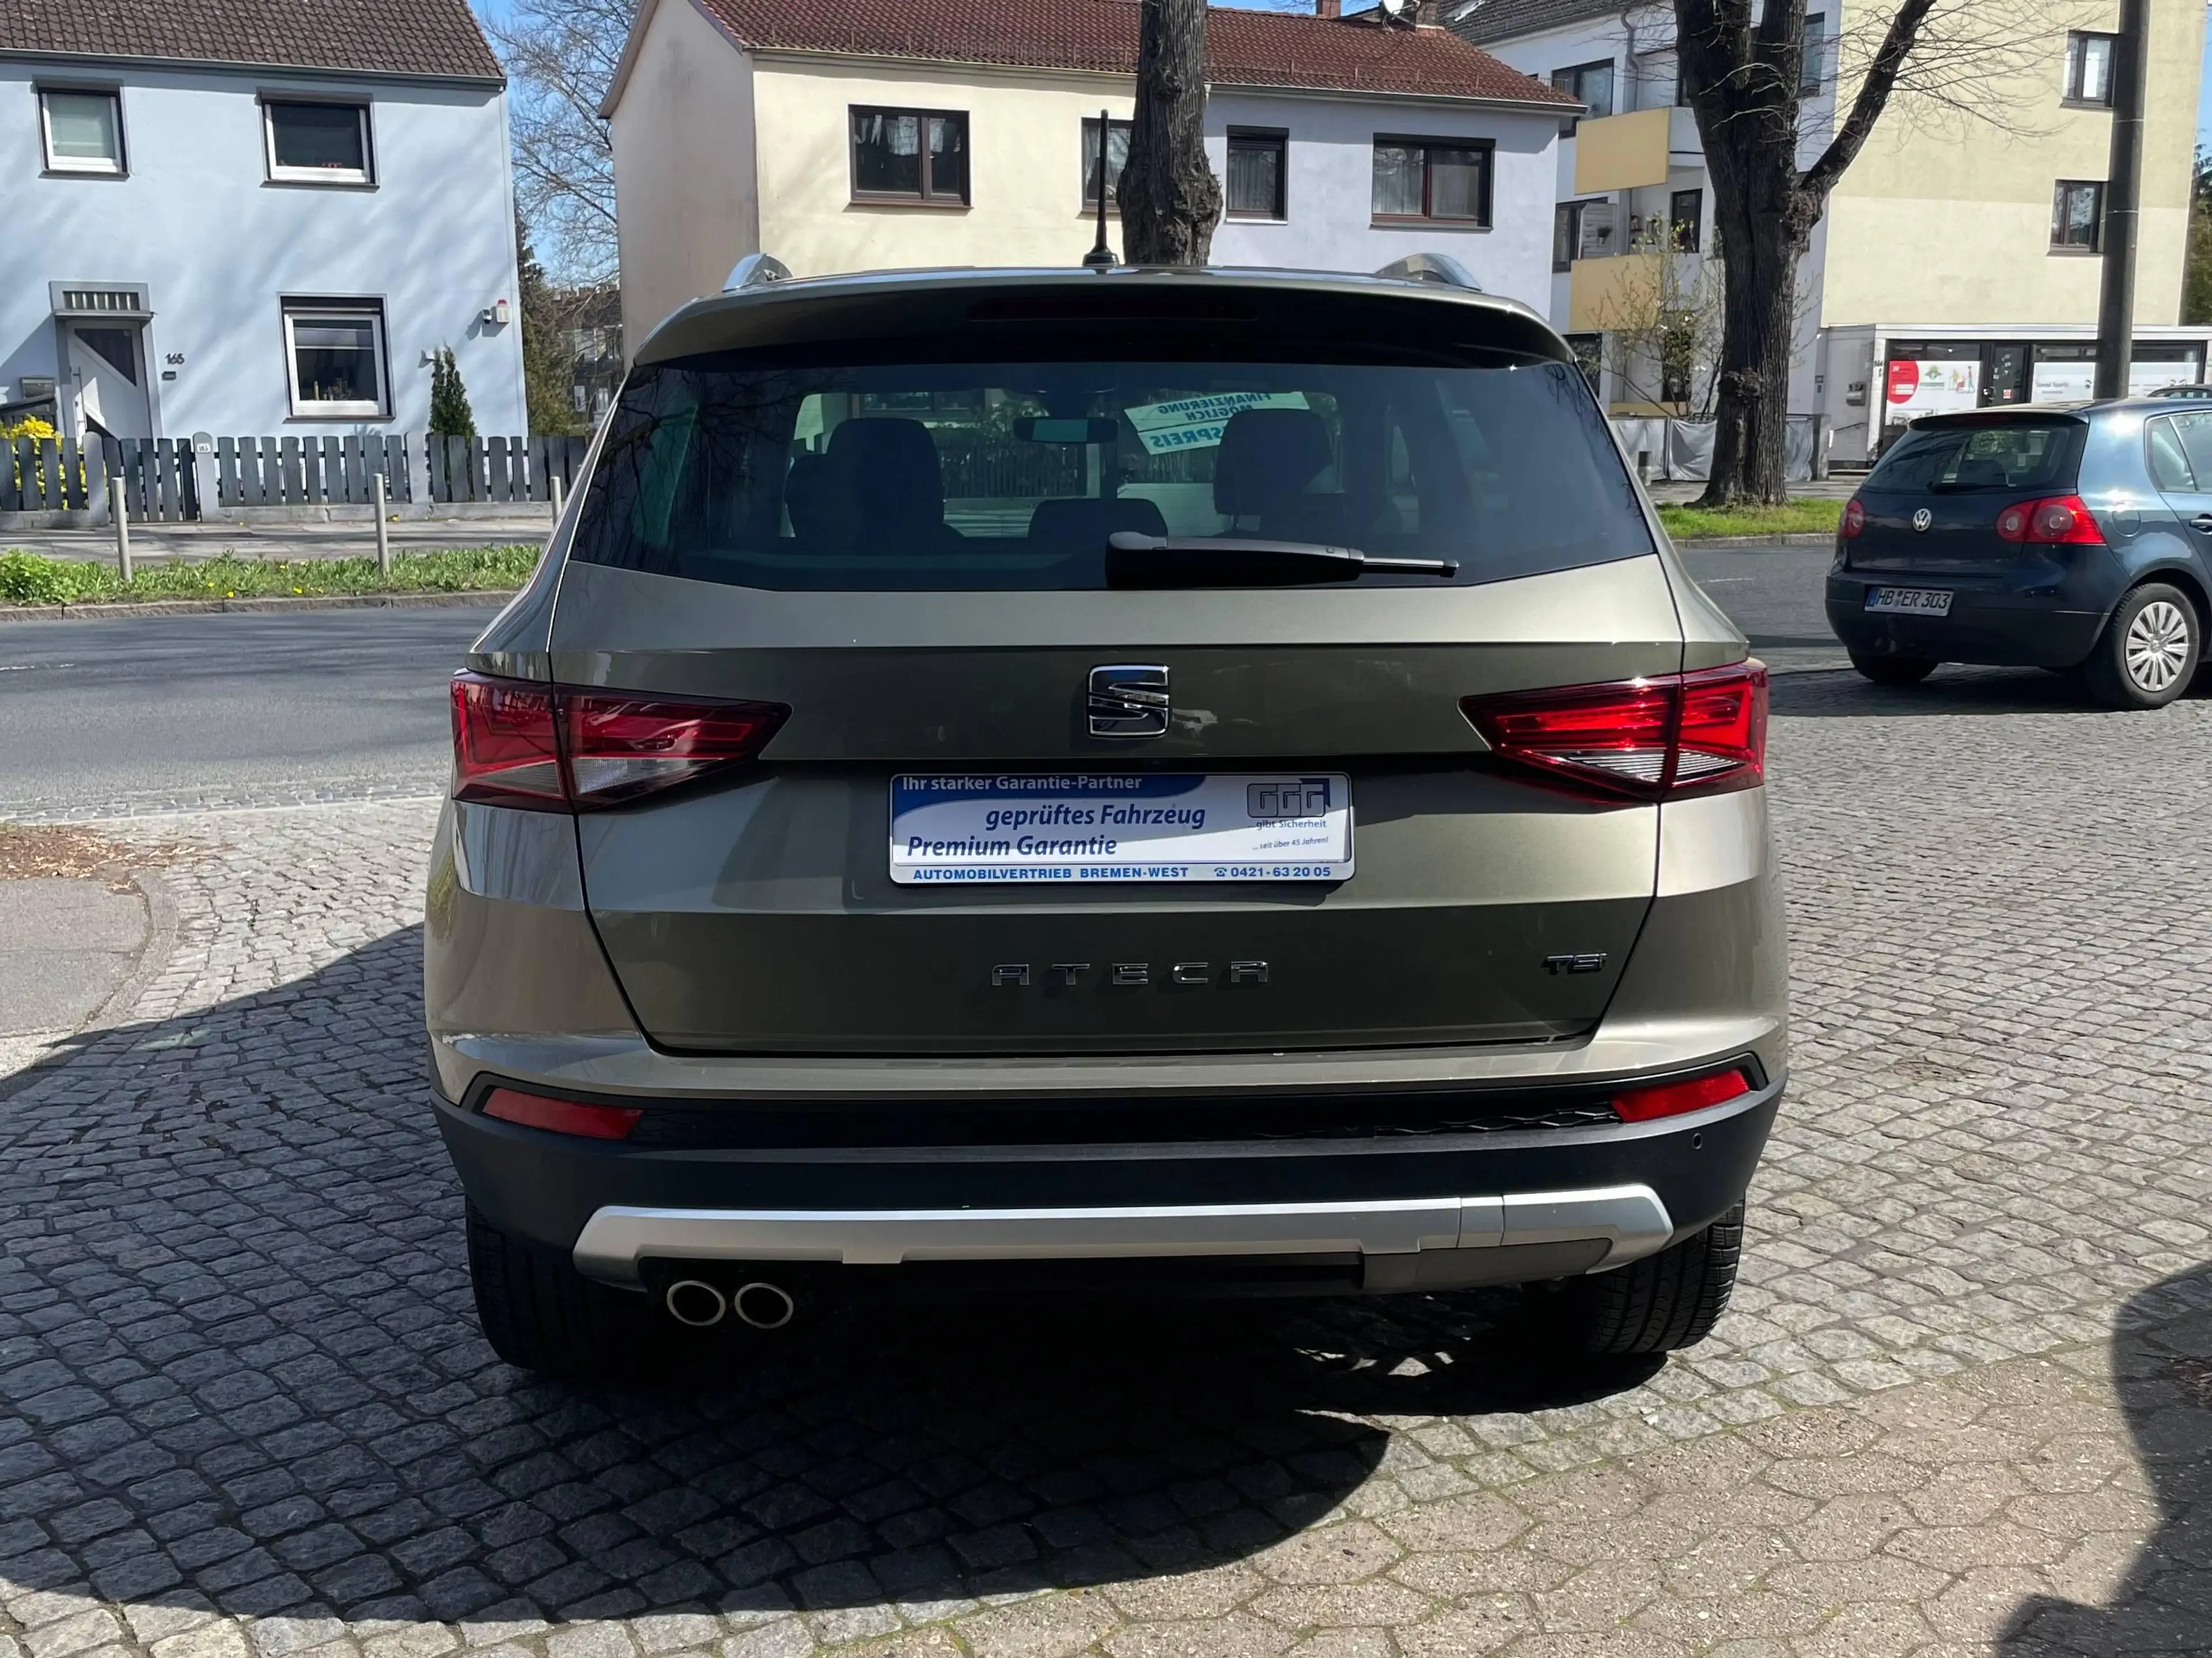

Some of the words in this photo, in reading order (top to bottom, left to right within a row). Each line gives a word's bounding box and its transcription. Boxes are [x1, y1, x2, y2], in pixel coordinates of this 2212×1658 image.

[1876, 589, 1895, 605] HB
[1900, 591, 1921, 607] ER
[1921, 592, 1950, 609] 303
[903, 776, 926, 790] Ihr
[931, 776, 992, 790] starker
[996, 775, 1142, 790] Garantie-Partner
[986, 804, 1094, 830] geprüftes
[1100, 803, 1206, 829] Fahrzeug
[1278, 819, 1327, 828] Sicherheit
[907, 835, 1010, 856] Premium
[1017, 834, 1118, 855] Garantie
[1273, 840, 1290, 848] über
[913, 868, 1072, 880] AUTOMOBILVERTRIEB
[1080, 867, 1188, 879] BREMEN-WEST
[1547, 953, 1607, 972] TSI
[991, 961, 1269, 987] ATECA
